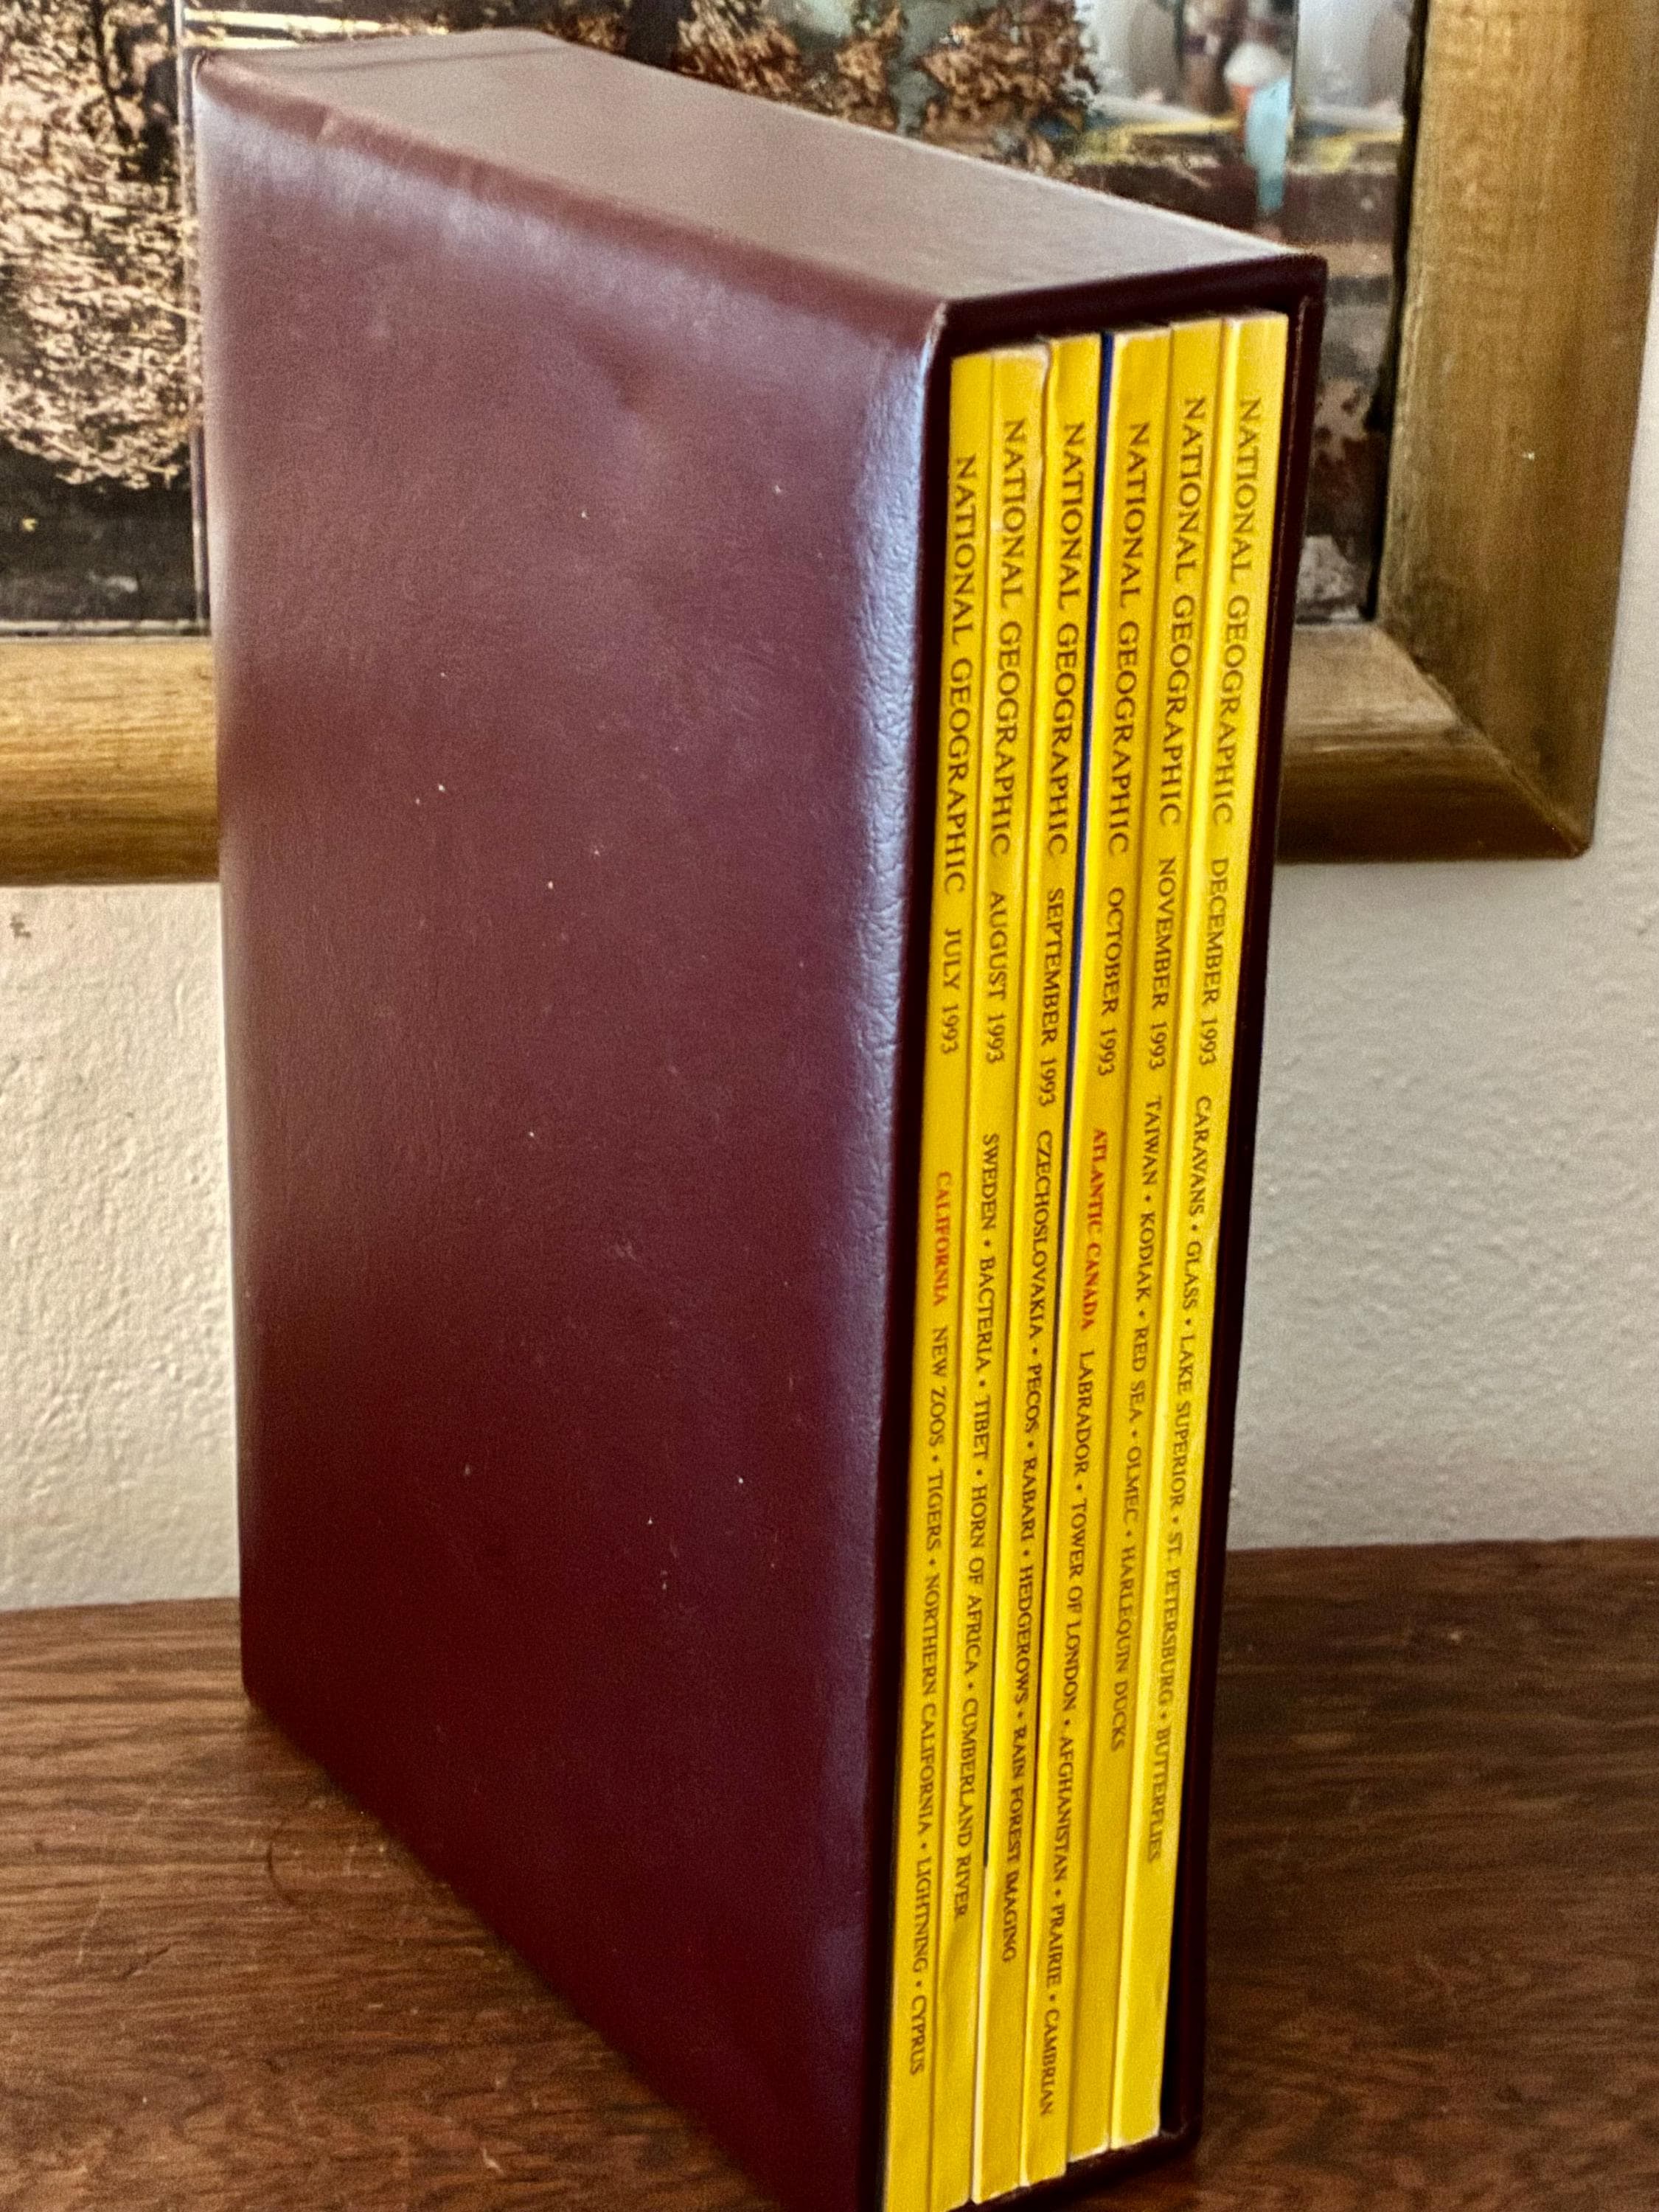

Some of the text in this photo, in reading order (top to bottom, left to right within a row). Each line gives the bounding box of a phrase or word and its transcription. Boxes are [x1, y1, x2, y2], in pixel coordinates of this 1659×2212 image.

[1230, 397, 1262, 585] NATIONAL
[1211, 594, 1250, 827] GEOGRAPHIC
[1201, 856, 1229, 1007] DECEMBER
[1110, 396, 1206, 1753] NATIONAL GEOGRAPHIC NOVEMBER 1993 TAIWAN KODIAK RED SEA OLMEC HARLEQUIN DUCKS
[1198, 1018, 1218, 1067] 1993
[953, 417, 1027, 1919] NATIONAL GEOGRAPHIC AUGUST 1993 SWEDEN BACTERIA TIBET HORN OF AFRICA CUMBERLAND RIVER
[1001, 420, 1085, 1964] NATIONAL GEOGRAPHIC SEPTEMBER 1993 CZECHOSLOVAKIA PECOS RABARI HEDGEROWS RAIN FOREST IMAGING
[1187, 1095, 1212, 1217] CARAVANS
[909, 453, 977, 2076] NATIONAL GEOGRAPHIC JULY 1993 CALIFORNIA NEW ZOOS TIGERS NORTHERN CALIFORNIA LIGHTNING CYPRUS
[1039, 422, 1150, 2118] NATIONAL GEOGRAPHIC OCTOBER 1993 ATLANTIC CANADA LABRADOR TOWER OF LONDON AFGHANISTAN PRAIRIE CAMBRIAN
[1182, 1240, 1203, 1312] GLASS
[1177, 1334, 1196, 1397] LAKE
[1169, 1400, 1192, 1511] SUPERIOR
[1158, 1567, 1181, 1721] PETERSBURG
[1144, 1725, 1172, 1865] BUTTERFLIES
